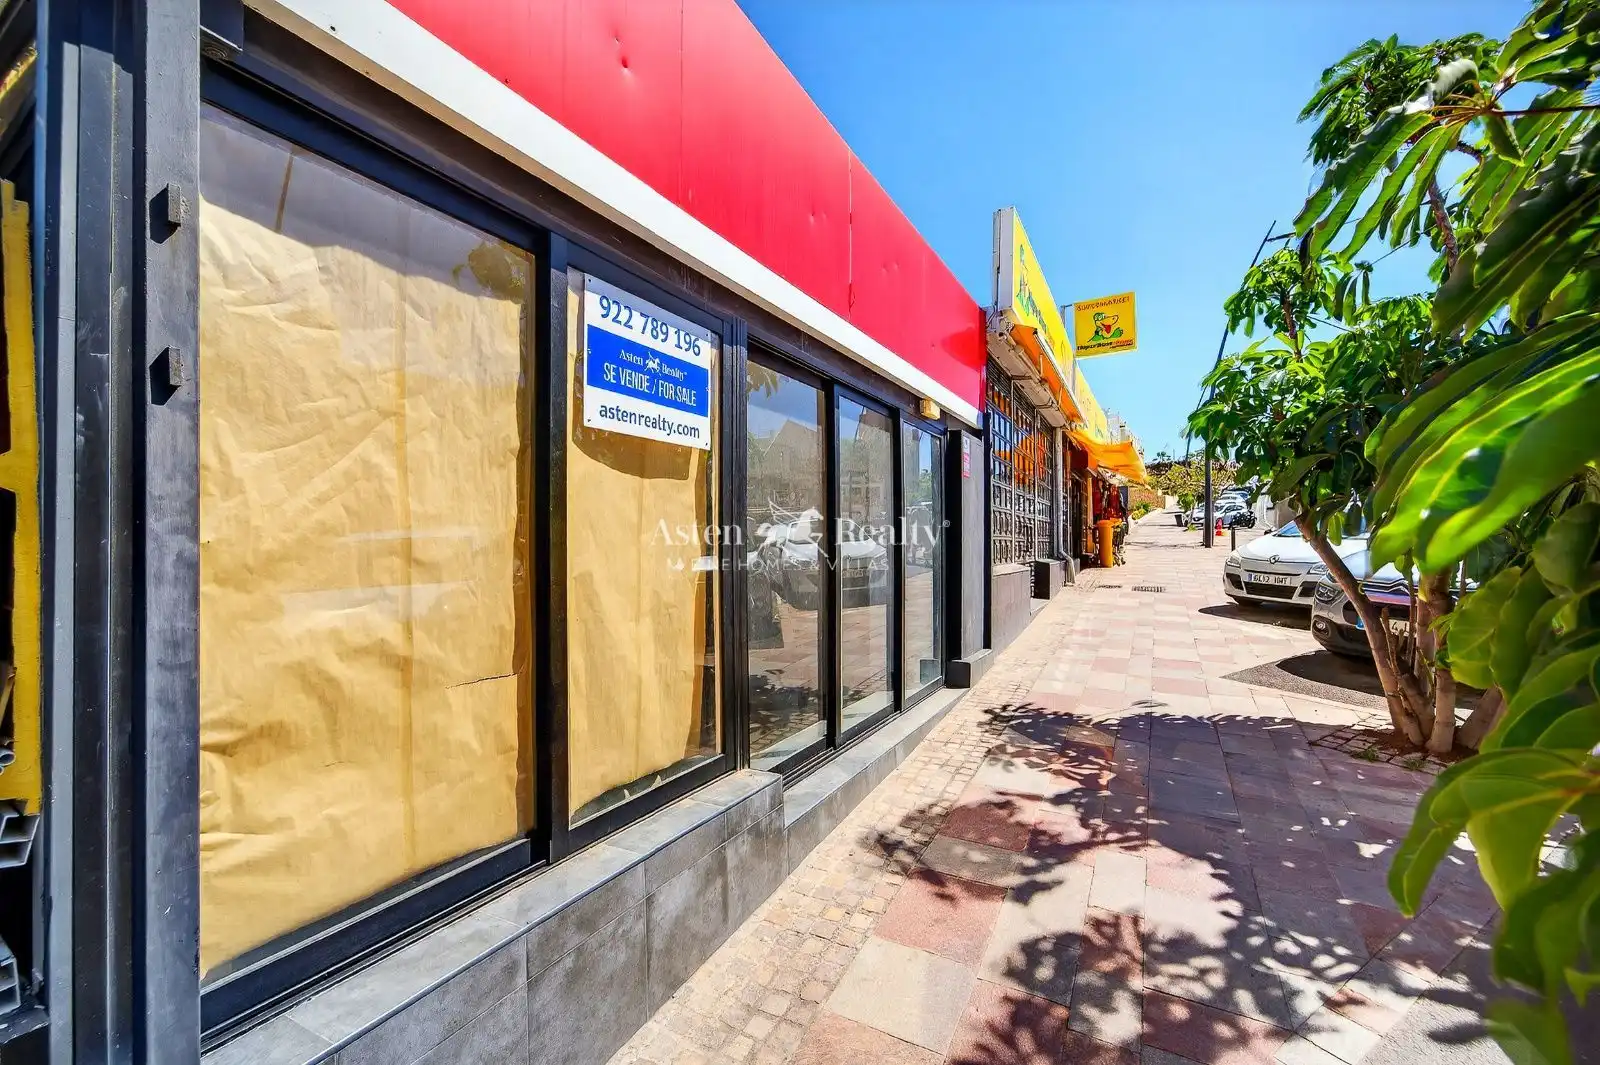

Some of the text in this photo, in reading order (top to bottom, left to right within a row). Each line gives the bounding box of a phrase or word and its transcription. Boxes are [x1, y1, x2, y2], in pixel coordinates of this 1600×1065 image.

[599, 295, 701, 357] 922 789 196
[619, 349, 644, 366] Asten
[603, 362, 617, 383] SE
[619, 365, 651, 394] VENDE
[658, 380, 675, 401] FOR
[676, 386, 697, 407] SALE
[599, 403, 700, 439] astenrealty.com
